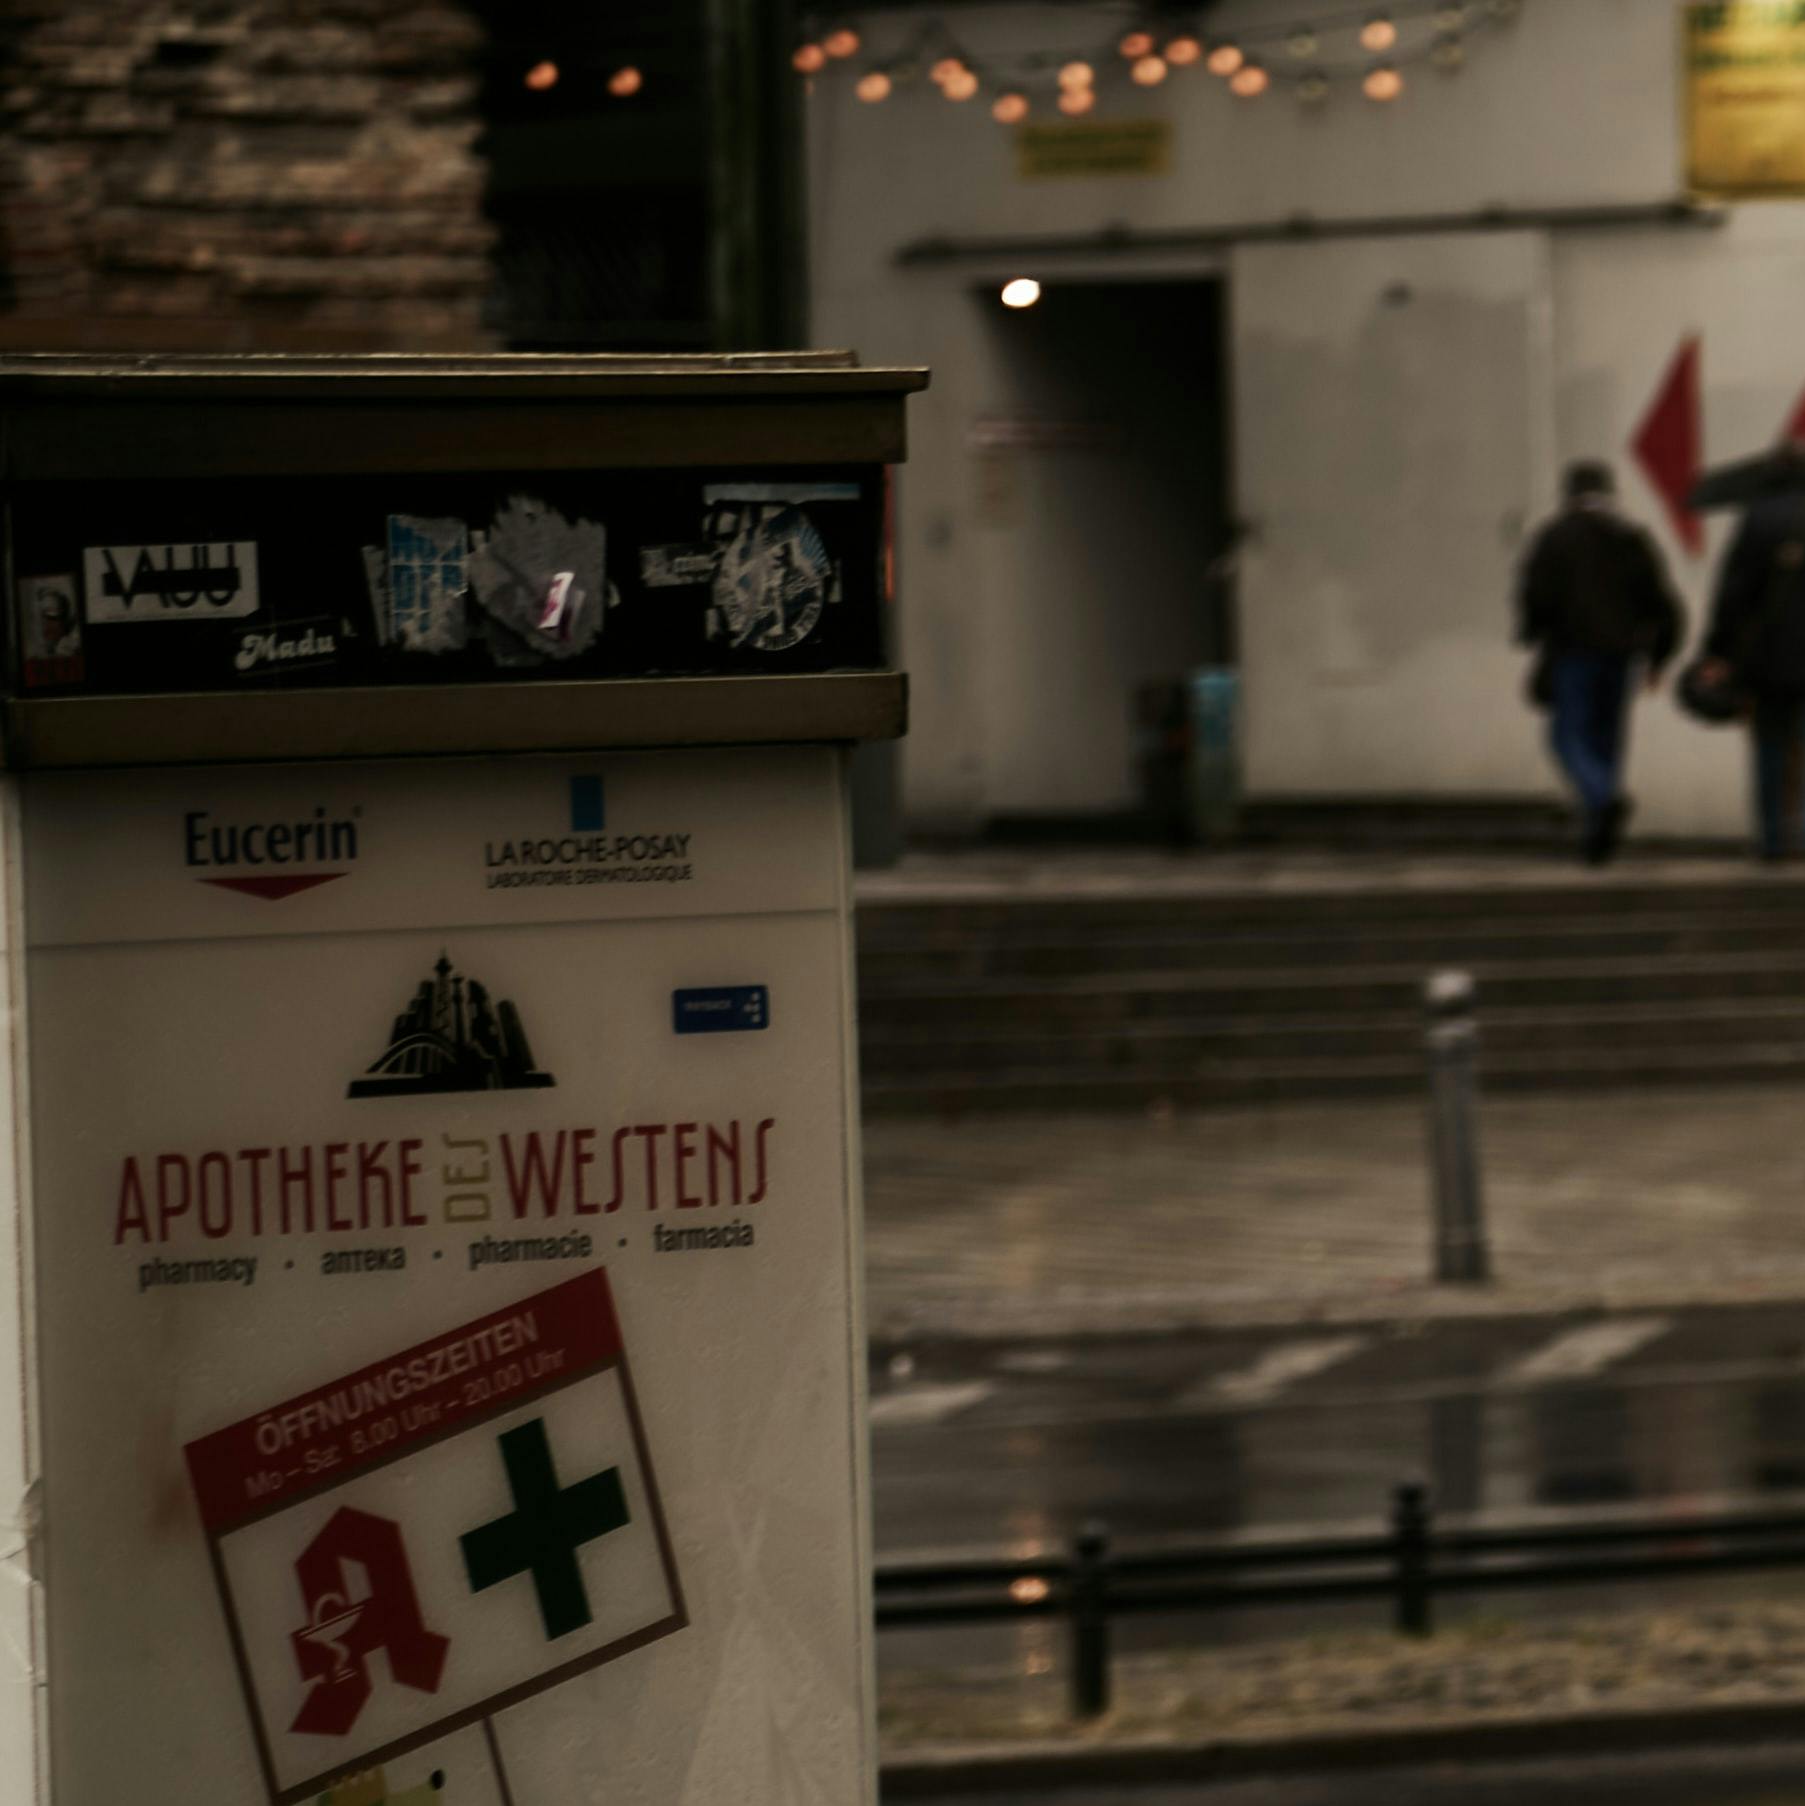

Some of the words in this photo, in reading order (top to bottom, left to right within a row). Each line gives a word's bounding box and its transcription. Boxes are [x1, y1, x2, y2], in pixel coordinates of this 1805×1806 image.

[115, 1138, 428, 1246] APOTHEKE
[441, 1132, 491, 1224] DES
[499, 1118, 775, 1220] WESTENS
[138, 1257, 257, 1293] pharmacy
[321, 1247, 406, 1275] аптека
[469, 1229, 593, 1271] pharmacie
[653, 1218, 755, 1252] farmacia
[254, 1311, 540, 1457] ÖFFNUNGSZEITEN
[399, 1398, 442, 1432] Uhr
[525, 1347, 568, 1380] Uhr
